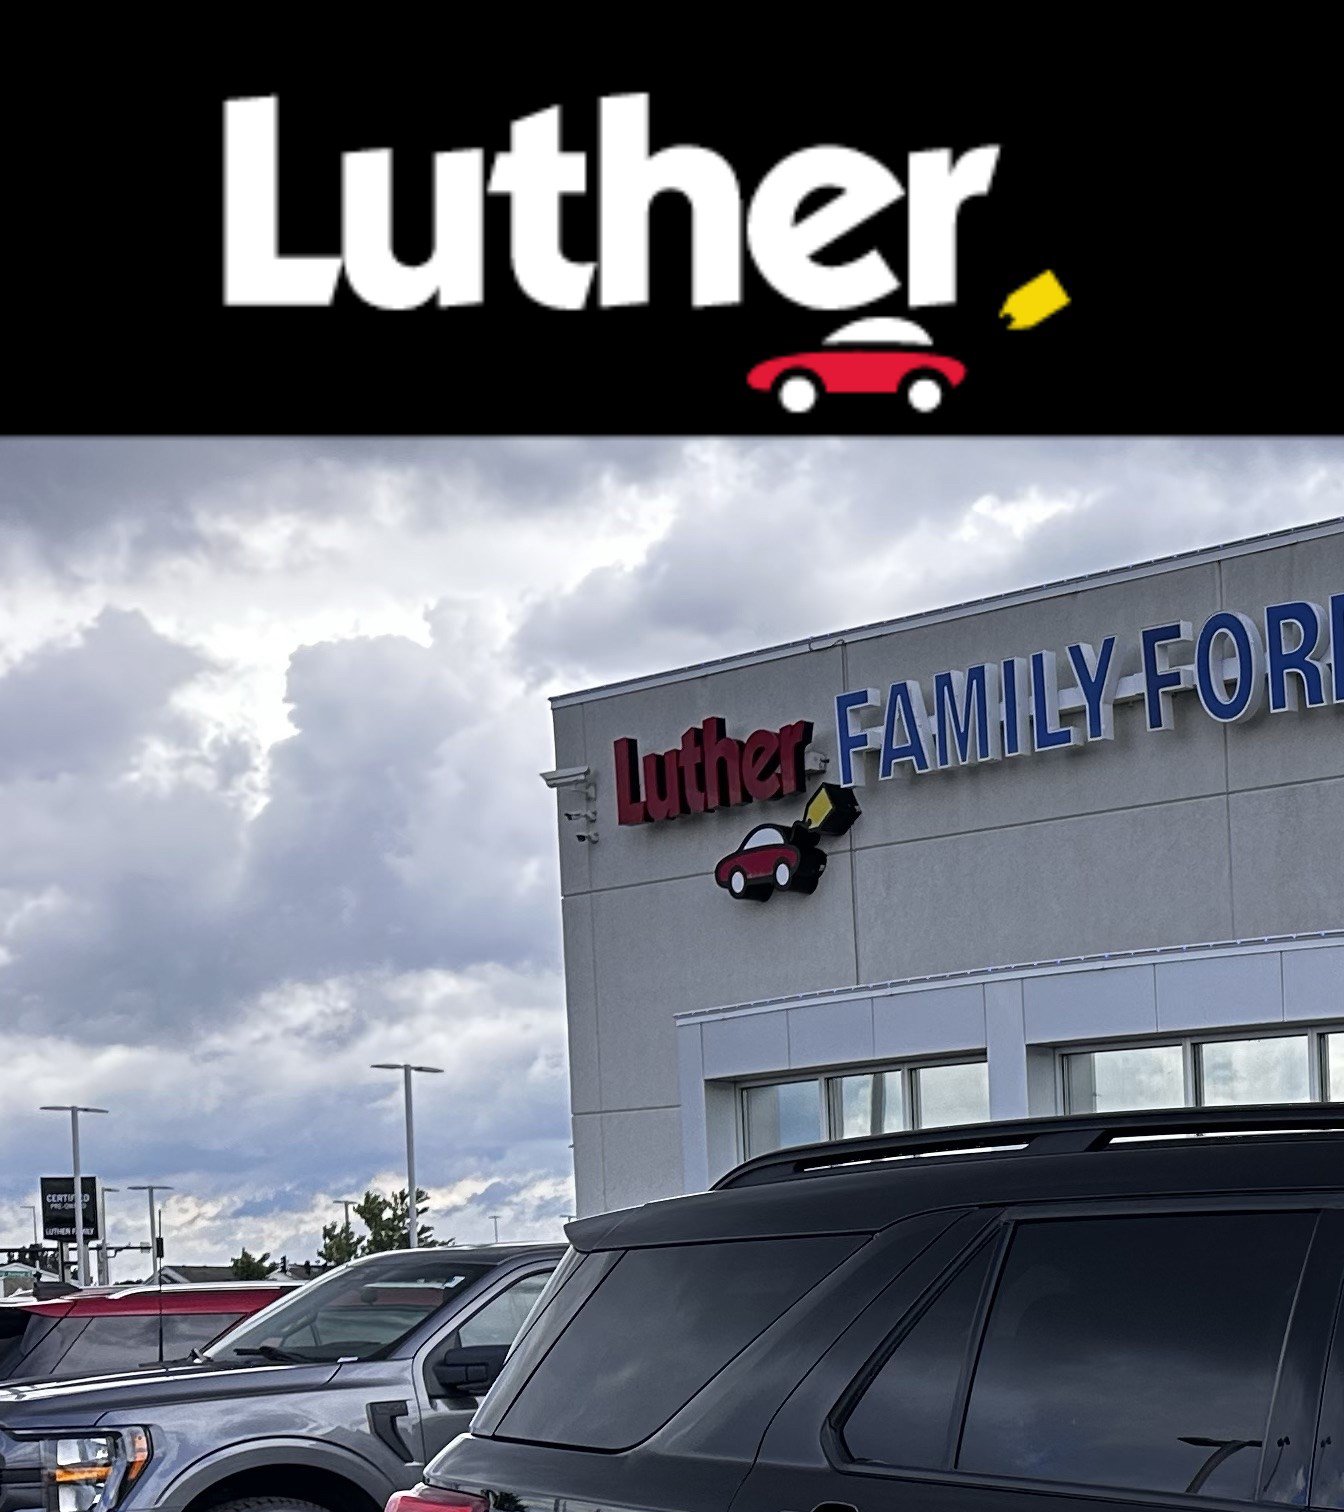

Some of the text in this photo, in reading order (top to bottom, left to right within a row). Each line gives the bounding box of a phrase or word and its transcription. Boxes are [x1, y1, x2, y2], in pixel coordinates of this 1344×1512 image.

[833, 634, 1117, 789] FAMILY
[613, 716, 815, 827] Luther
[46, 1193, 90, 1203] CERTIFD
